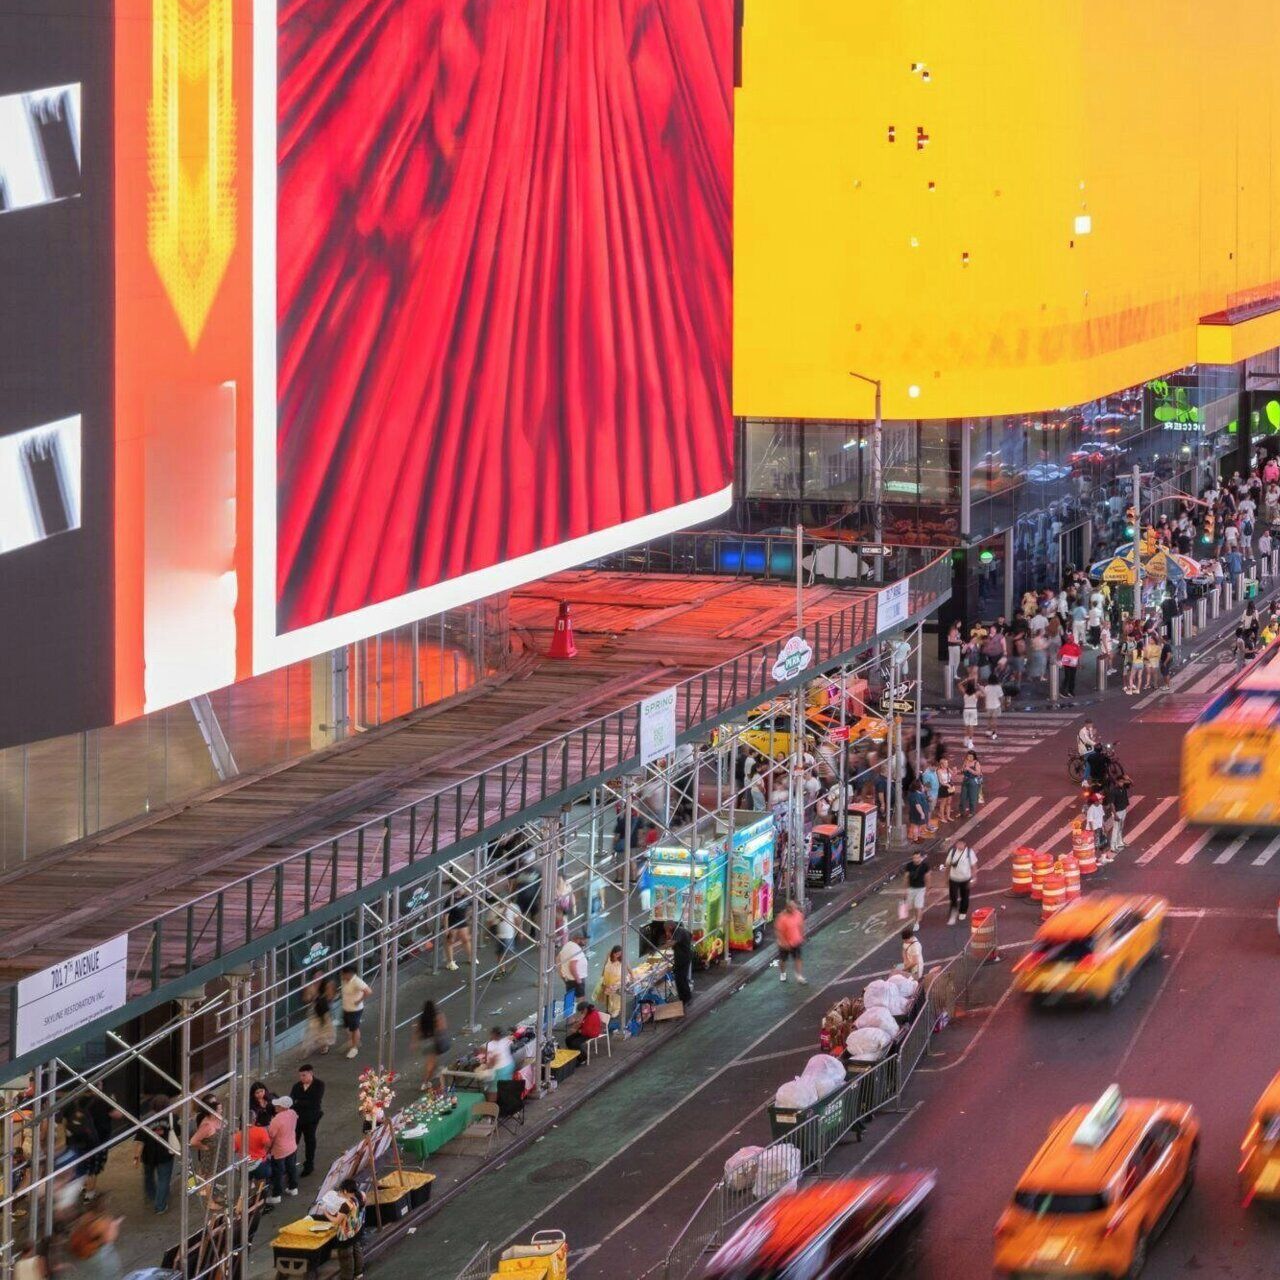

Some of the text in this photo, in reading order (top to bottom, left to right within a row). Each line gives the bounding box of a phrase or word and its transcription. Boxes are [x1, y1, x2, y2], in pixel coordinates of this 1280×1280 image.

[644, 695, 673, 716] SPRING
[51, 969, 63, 990] 701
[74, 951, 100, 980] AVENUE
[43, 1009, 63, 1026] SKYLINE
[63, 996, 96, 1017] RESTORATION
